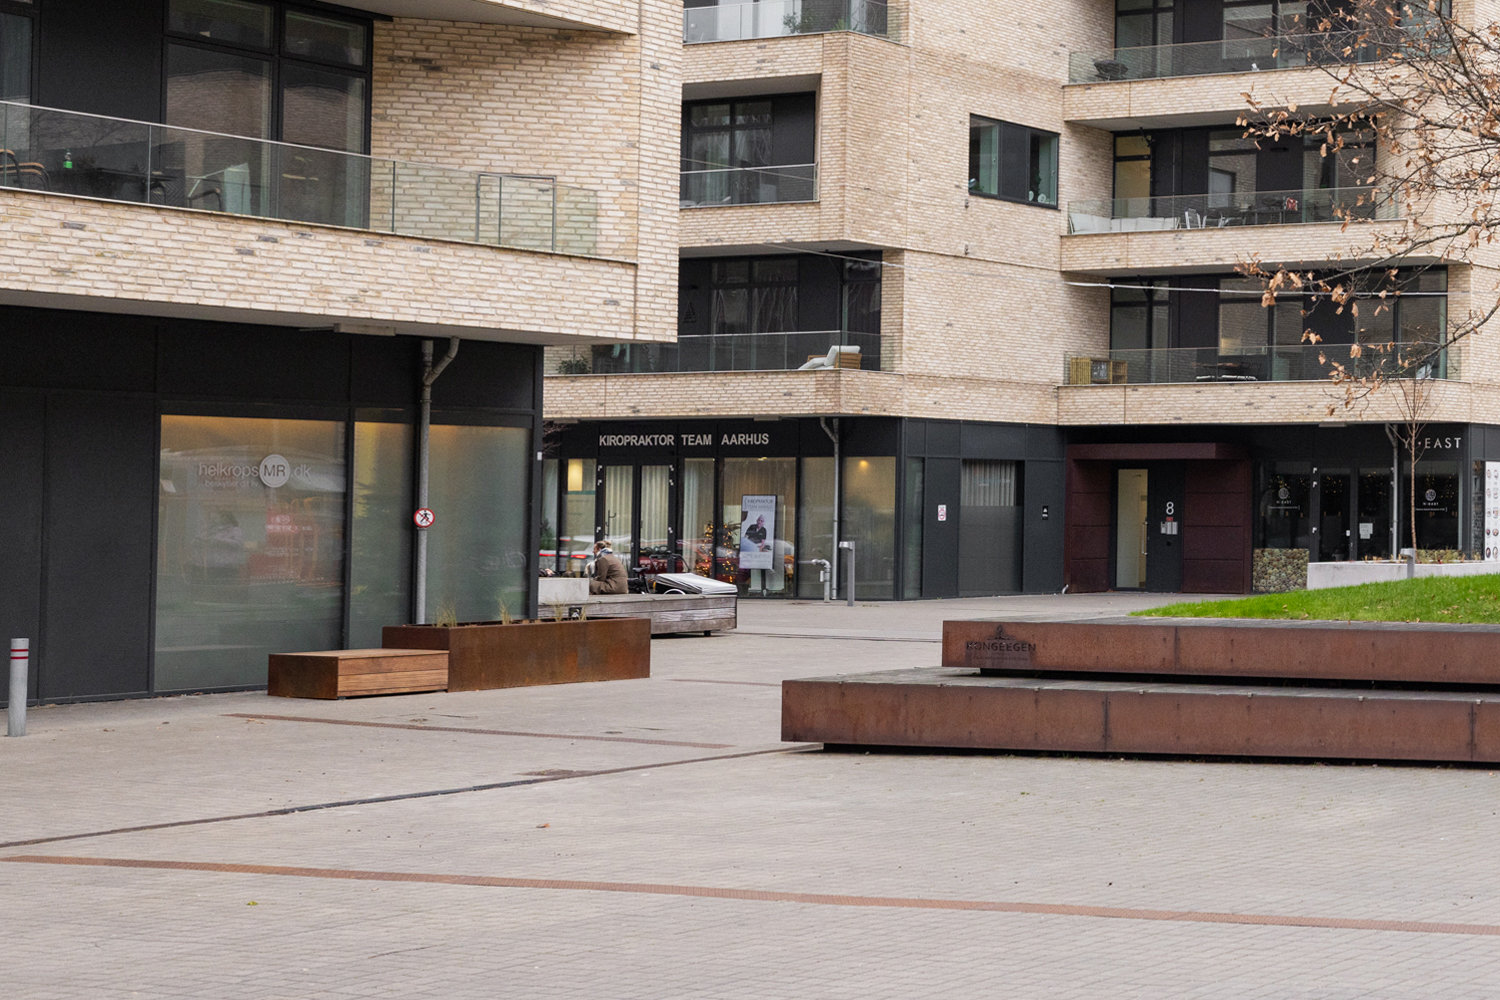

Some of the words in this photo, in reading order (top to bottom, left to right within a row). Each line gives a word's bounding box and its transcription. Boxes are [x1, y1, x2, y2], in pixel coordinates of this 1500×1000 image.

[599, 434, 675, 446] KIROPRAKTOR
[681, 434, 712, 446] TEAM
[721, 433, 769, 445] AARHUS
[1166, 501, 1174, 515] 8
